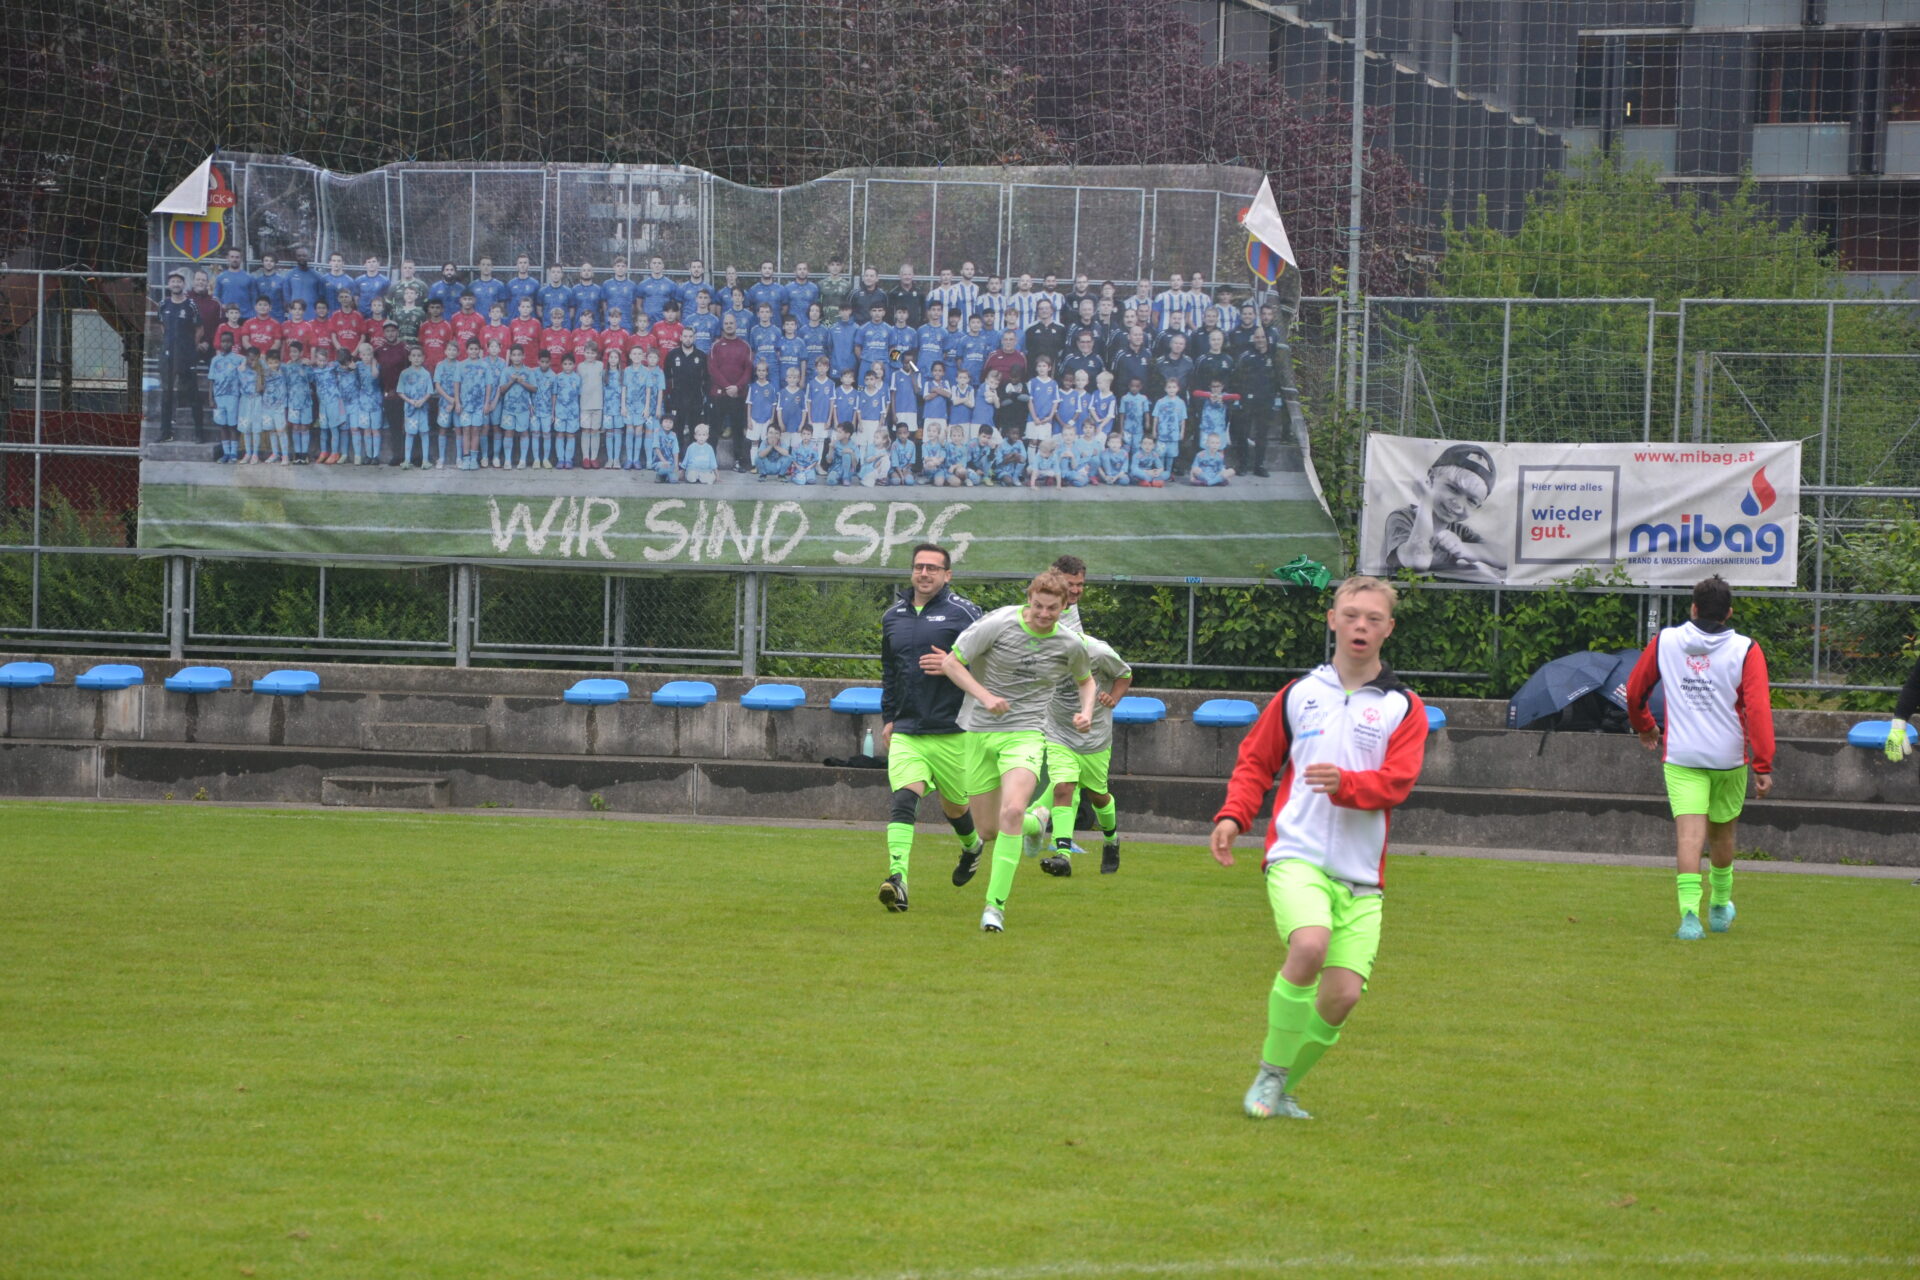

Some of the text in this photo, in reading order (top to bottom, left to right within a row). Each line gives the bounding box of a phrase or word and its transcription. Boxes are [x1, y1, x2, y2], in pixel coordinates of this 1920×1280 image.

[1634, 451, 1755, 465] www.mibag.at
[1532, 483, 1603, 492] Hier wird alles
[1531, 505, 1602, 521] wieder
[487, 495, 973, 566] WIR SIND SPG
[1531, 524, 1571, 541] gut.
[1629, 514, 1785, 565] mibag
[1628, 557, 1760, 565] BRAND & WASSERSCHADENSANIERUNG
